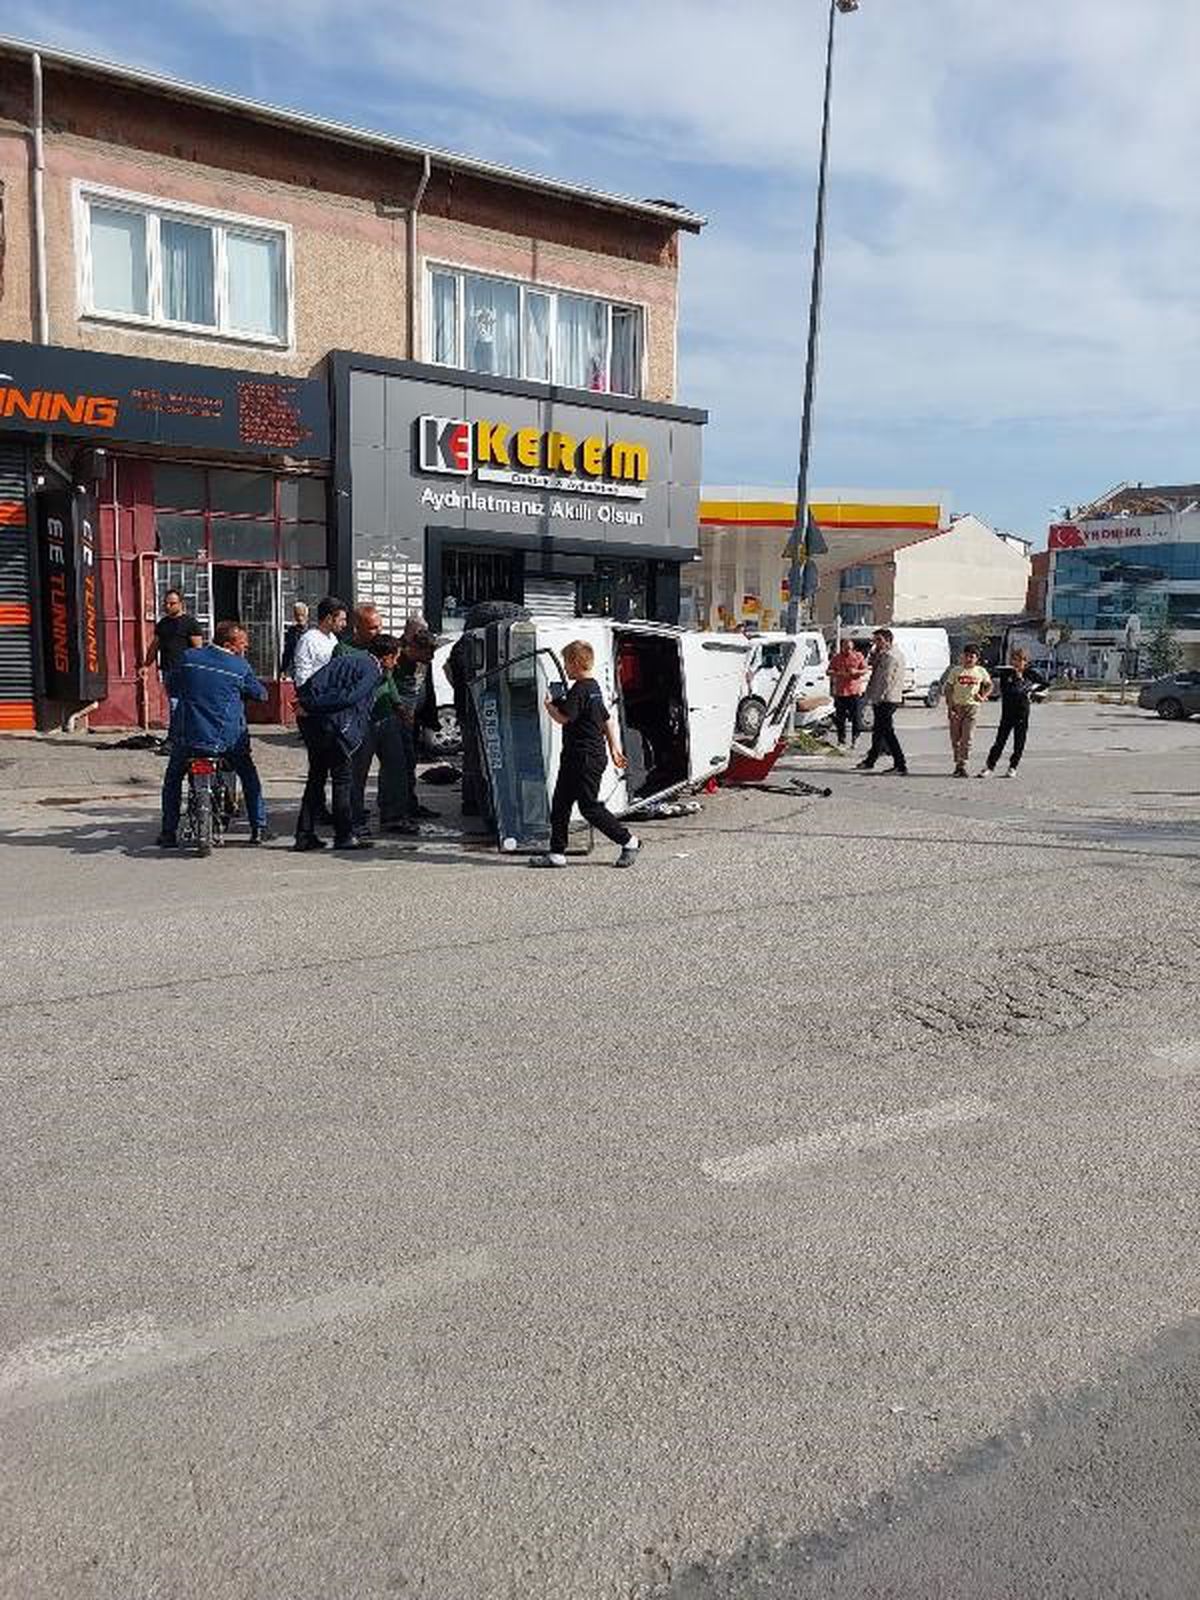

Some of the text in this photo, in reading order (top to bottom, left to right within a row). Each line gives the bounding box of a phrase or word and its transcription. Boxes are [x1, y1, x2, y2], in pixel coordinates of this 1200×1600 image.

[421, 488, 644, 526] Aydınlatmanız Akıllı Olsun
[50, 575, 69, 673] TUNING
